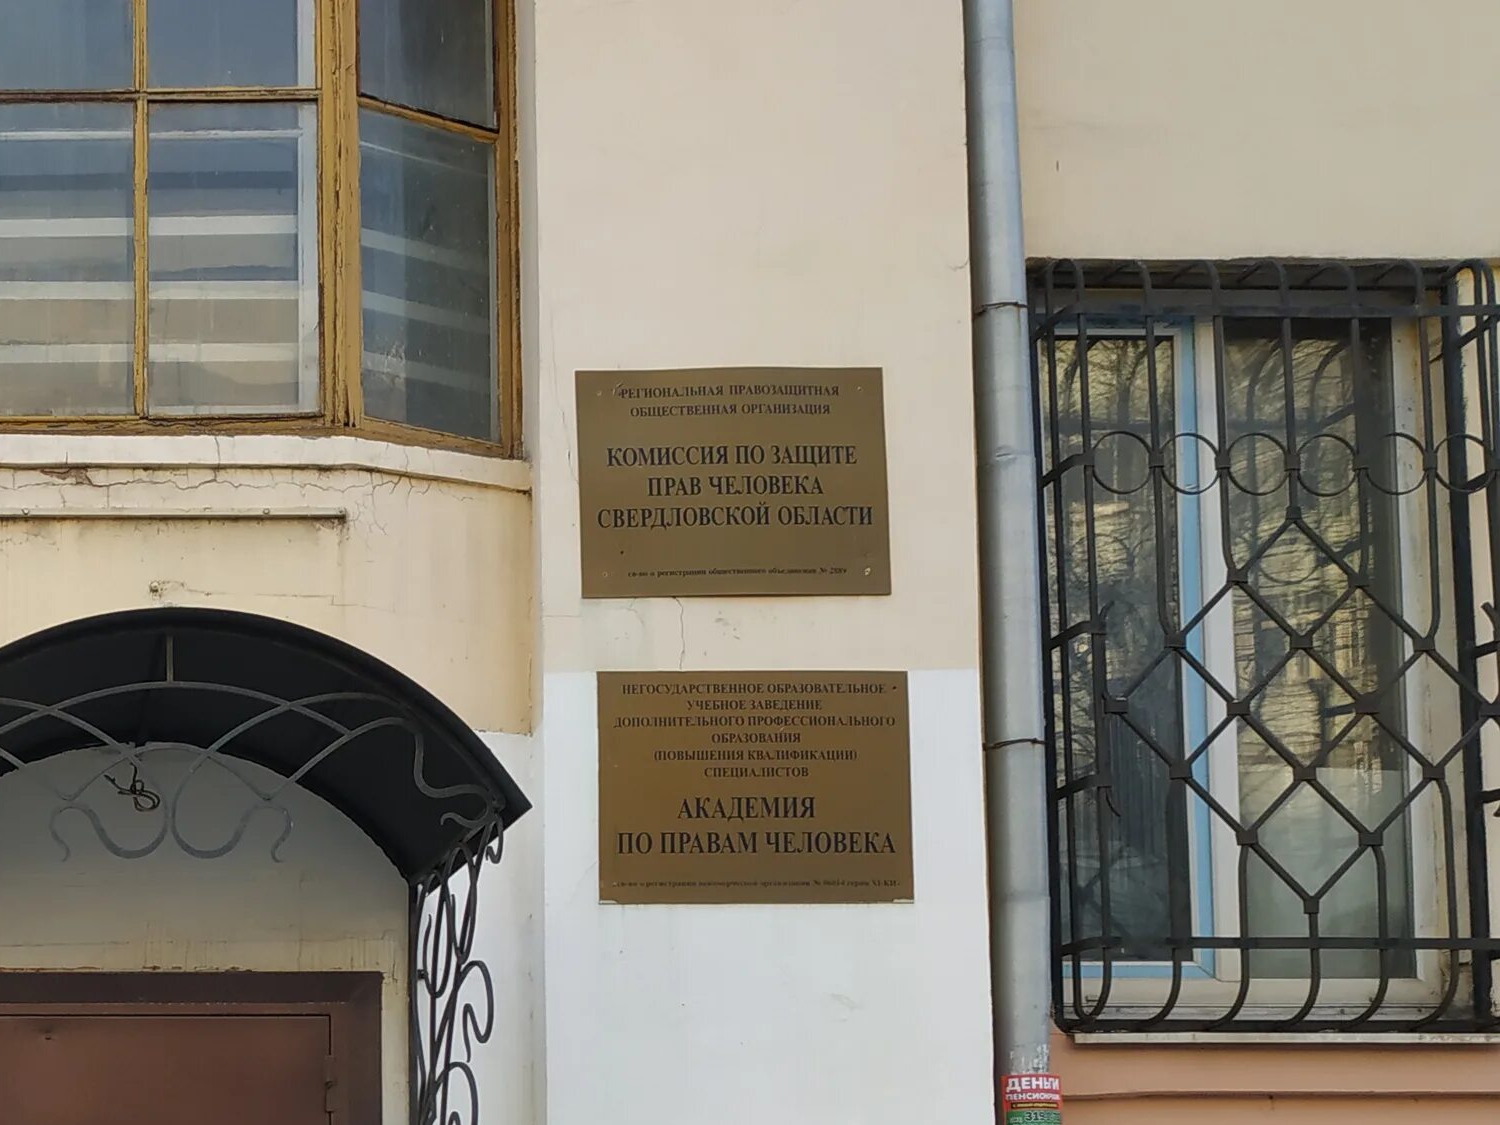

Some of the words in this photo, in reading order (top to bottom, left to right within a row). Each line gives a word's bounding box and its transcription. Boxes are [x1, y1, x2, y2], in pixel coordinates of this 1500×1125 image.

[620, 384, 724, 399] РЕГИОНАЛЬНАЯ
[729, 384, 840, 397] ПРАВОЗАЩИТНАЯ
[630, 403, 737, 418] ОБЩЕСТВЕННАЯ
[741, 403, 831, 416] ОРГАНИЗАЦИЯ
[606, 446, 728, 467] КОМИССИЯ
[736, 445, 765, 465] ПО
[771, 445, 858, 467] ЗАЩИТЕ
[647, 476, 701, 496] ПРАВ
[707, 474, 824, 495] ЧЕЛОВЕКА
[597, 502, 771, 530] СВЕРДЛОВСКОЙ
[777, 505, 873, 526] ОБЛАСТИ
[621, 683, 765, 696] НЕГОСУДАРСТВЕННОЕ
[766, 682, 886, 695] ОБРАЗОВАТЕЛЬНОЕ
[687, 699, 747, 712] УЧЕБНОЕ
[749, 699, 823, 711] ЗАВЕДЕНИЕ
[613, 716, 745, 729] ДОПОЛНИТЕЛЬНОГО
[747, 715, 896, 728] ПРОФЕССИОНАЛЬНОГО
[711, 732, 801, 744] ОБРАЗОВАНИЯ
[703, 766, 809, 779] СПЕЦИАЛИСТОВ
[677, 796, 816, 821] АКАДЕМИЯ
[616, 832, 653, 854] ПО
[661, 832, 757, 854] ПРАВАМ
[766, 831, 896, 854] ЧЕЛОВЕКА
